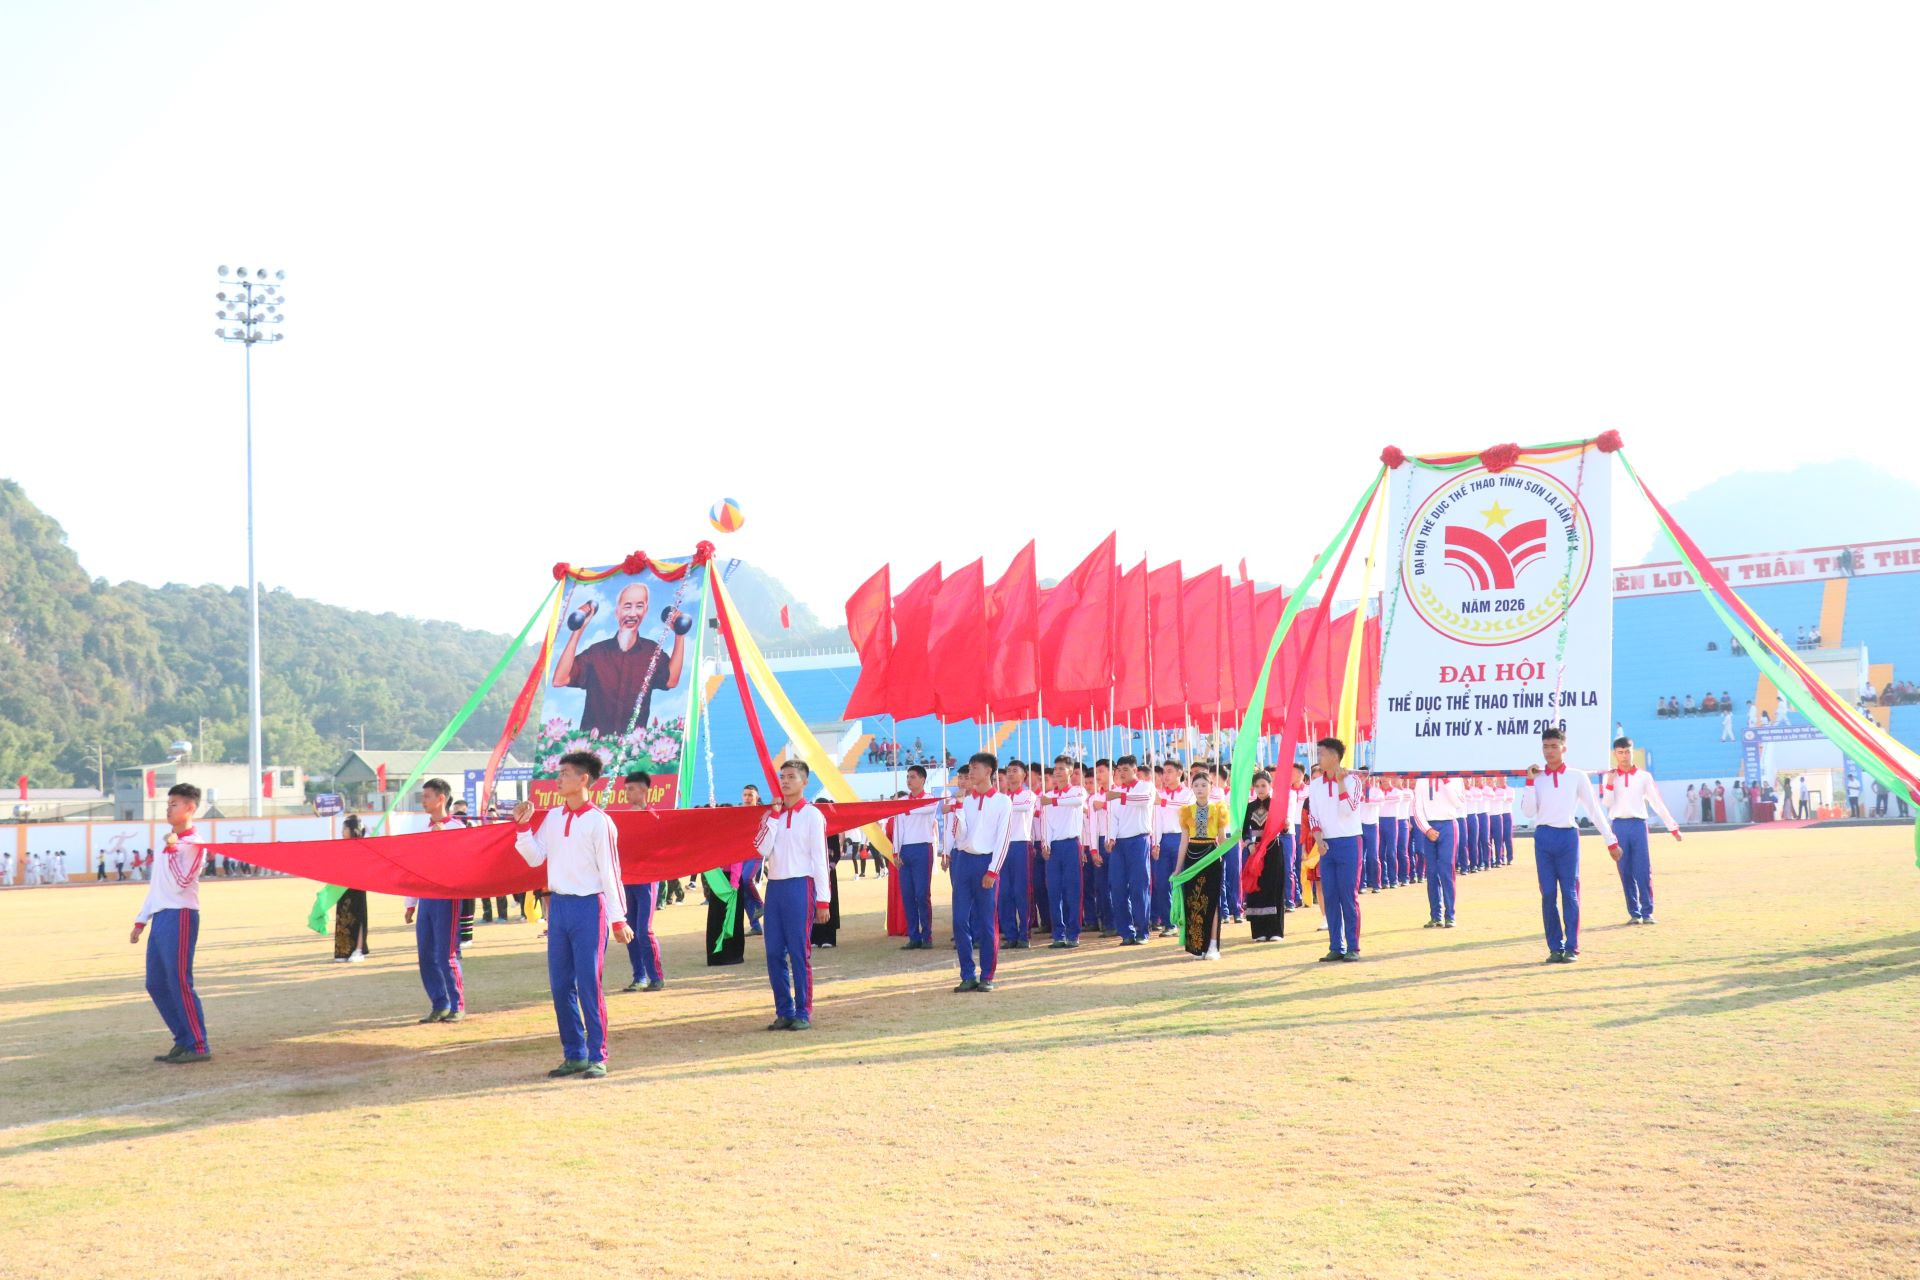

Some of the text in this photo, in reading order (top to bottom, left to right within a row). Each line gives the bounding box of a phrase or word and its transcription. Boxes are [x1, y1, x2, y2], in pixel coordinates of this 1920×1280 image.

[1469, 477, 1496, 492] THAO
[1524, 481, 1547, 497] SƠN
[1544, 492, 1558, 506] LA
[1430, 500, 1450, 520] DỤC
[1414, 539, 1428, 556] HỘI
[1414, 559, 1427, 575] ĐẠI
[1612, 572, 1645, 592] ÈN
[1652, 566, 1730, 588] LUYN
[1738, 557, 1805, 579] THÂN
[1461, 598, 1525, 614] NĂM 2026
[1439, 657, 1545, 689] ĐẠI HỘI
[1387, 690, 1413, 712] THỂ
[1415, 696, 1442, 715] DỤC
[1446, 688, 1471, 711] THỂ
[1474, 693, 1508, 710] THAO
[1513, 688, 1544, 708] TỈNH
[1581, 690, 1598, 707] LA
[1415, 716, 1441, 737] LẦN
[1445, 717, 1472, 737] THỨ
[1474, 720, 1483, 736] X
[1496, 716, 1529, 735] NĂM
[1533, 718, 1567, 735] 206
